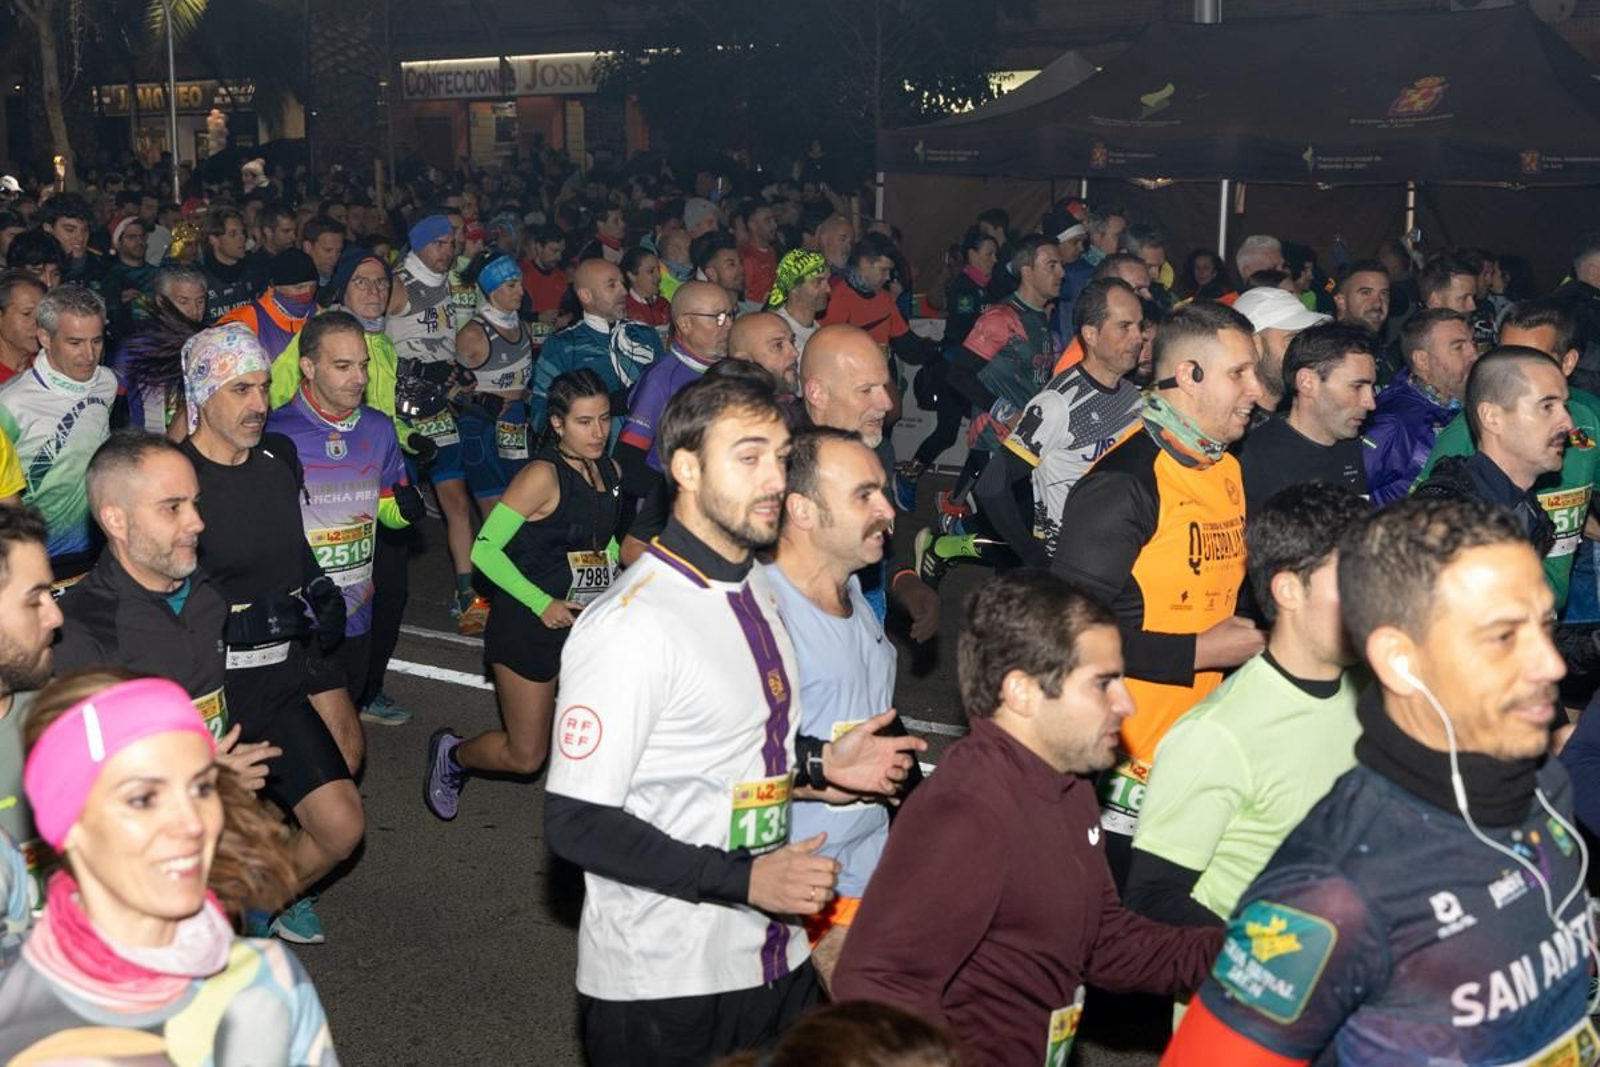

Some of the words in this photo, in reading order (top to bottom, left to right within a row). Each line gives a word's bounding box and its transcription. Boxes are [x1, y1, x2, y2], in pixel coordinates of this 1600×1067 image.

[405, 67, 516, 97] CONFECCIONS
[317, 538, 372, 568] 2519
[577, 567, 610, 587] 7989
[1450, 955, 1539, 1026] SAN
